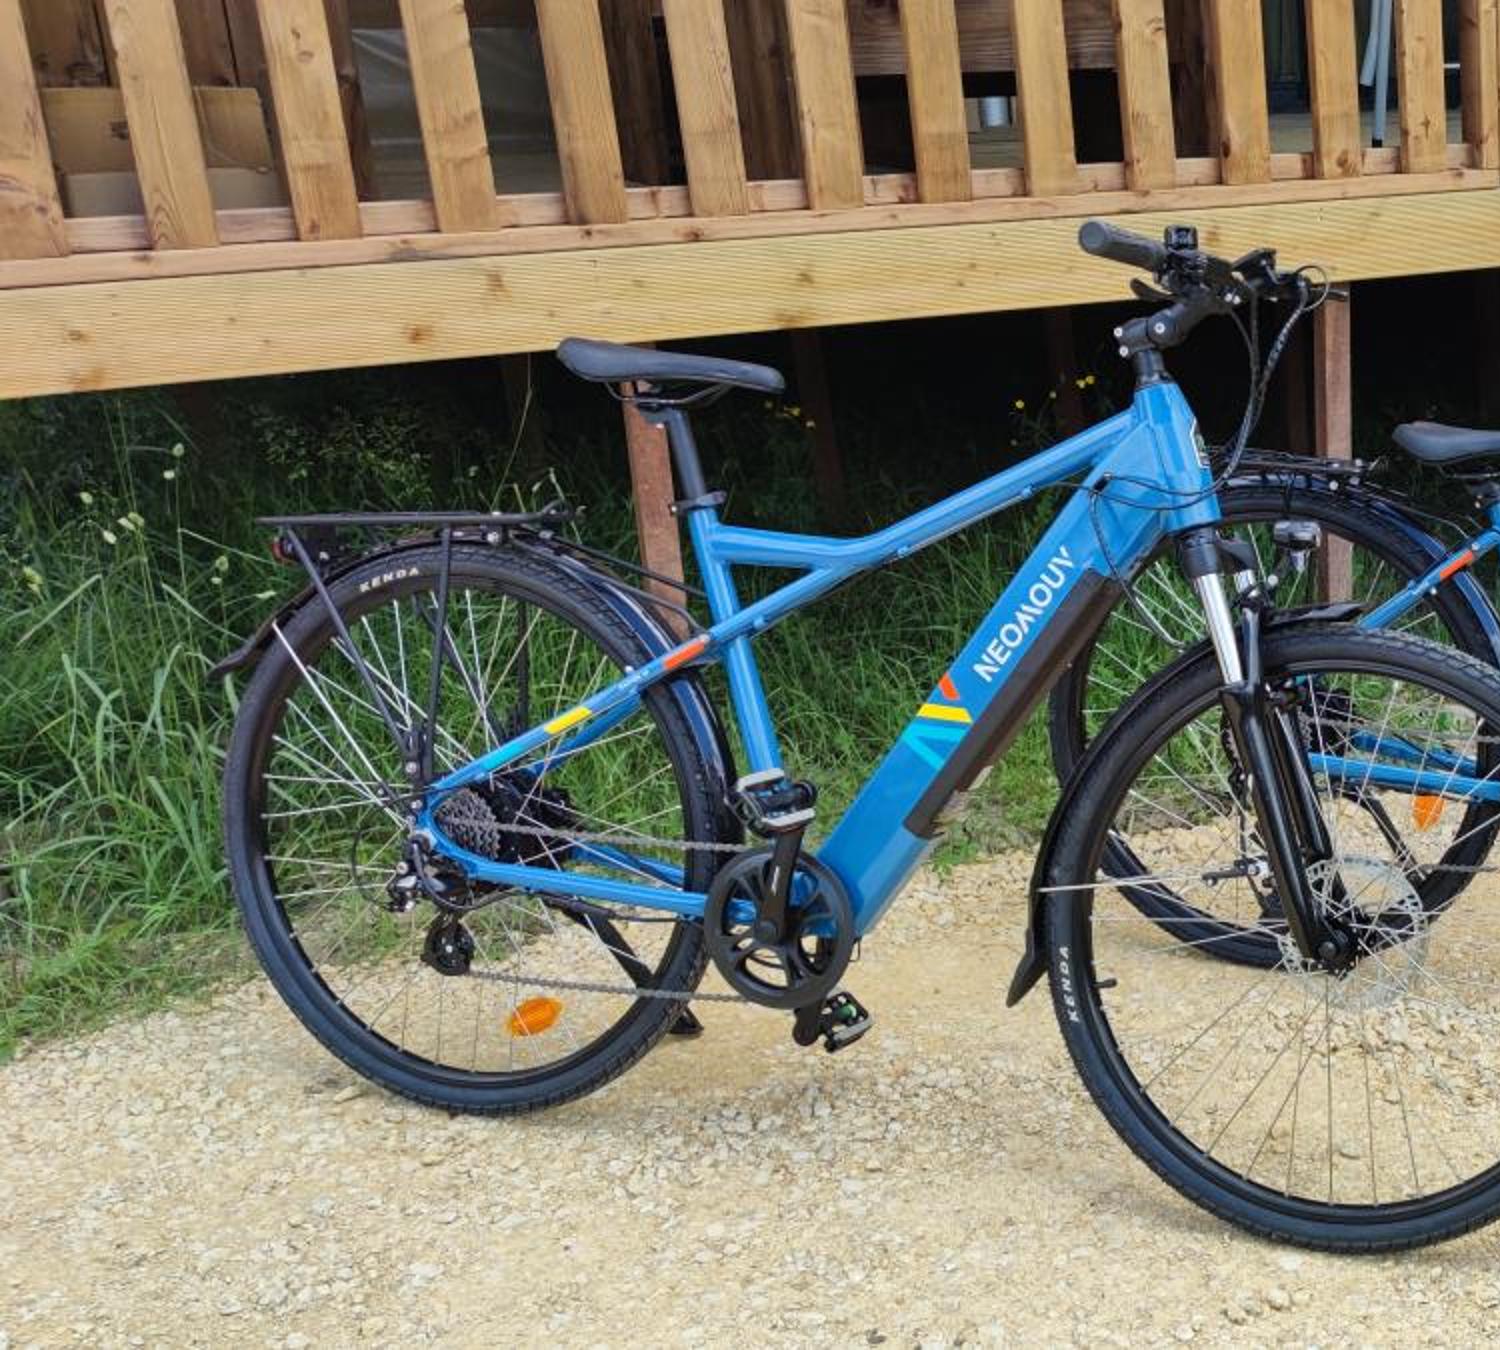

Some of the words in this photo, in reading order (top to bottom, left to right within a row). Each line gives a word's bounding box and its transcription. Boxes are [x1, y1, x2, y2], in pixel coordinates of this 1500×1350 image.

[359, 566, 420, 593] KENDA
[972, 545, 1076, 682] NEOMOUV
[1059, 946, 1080, 1022] KENDA
